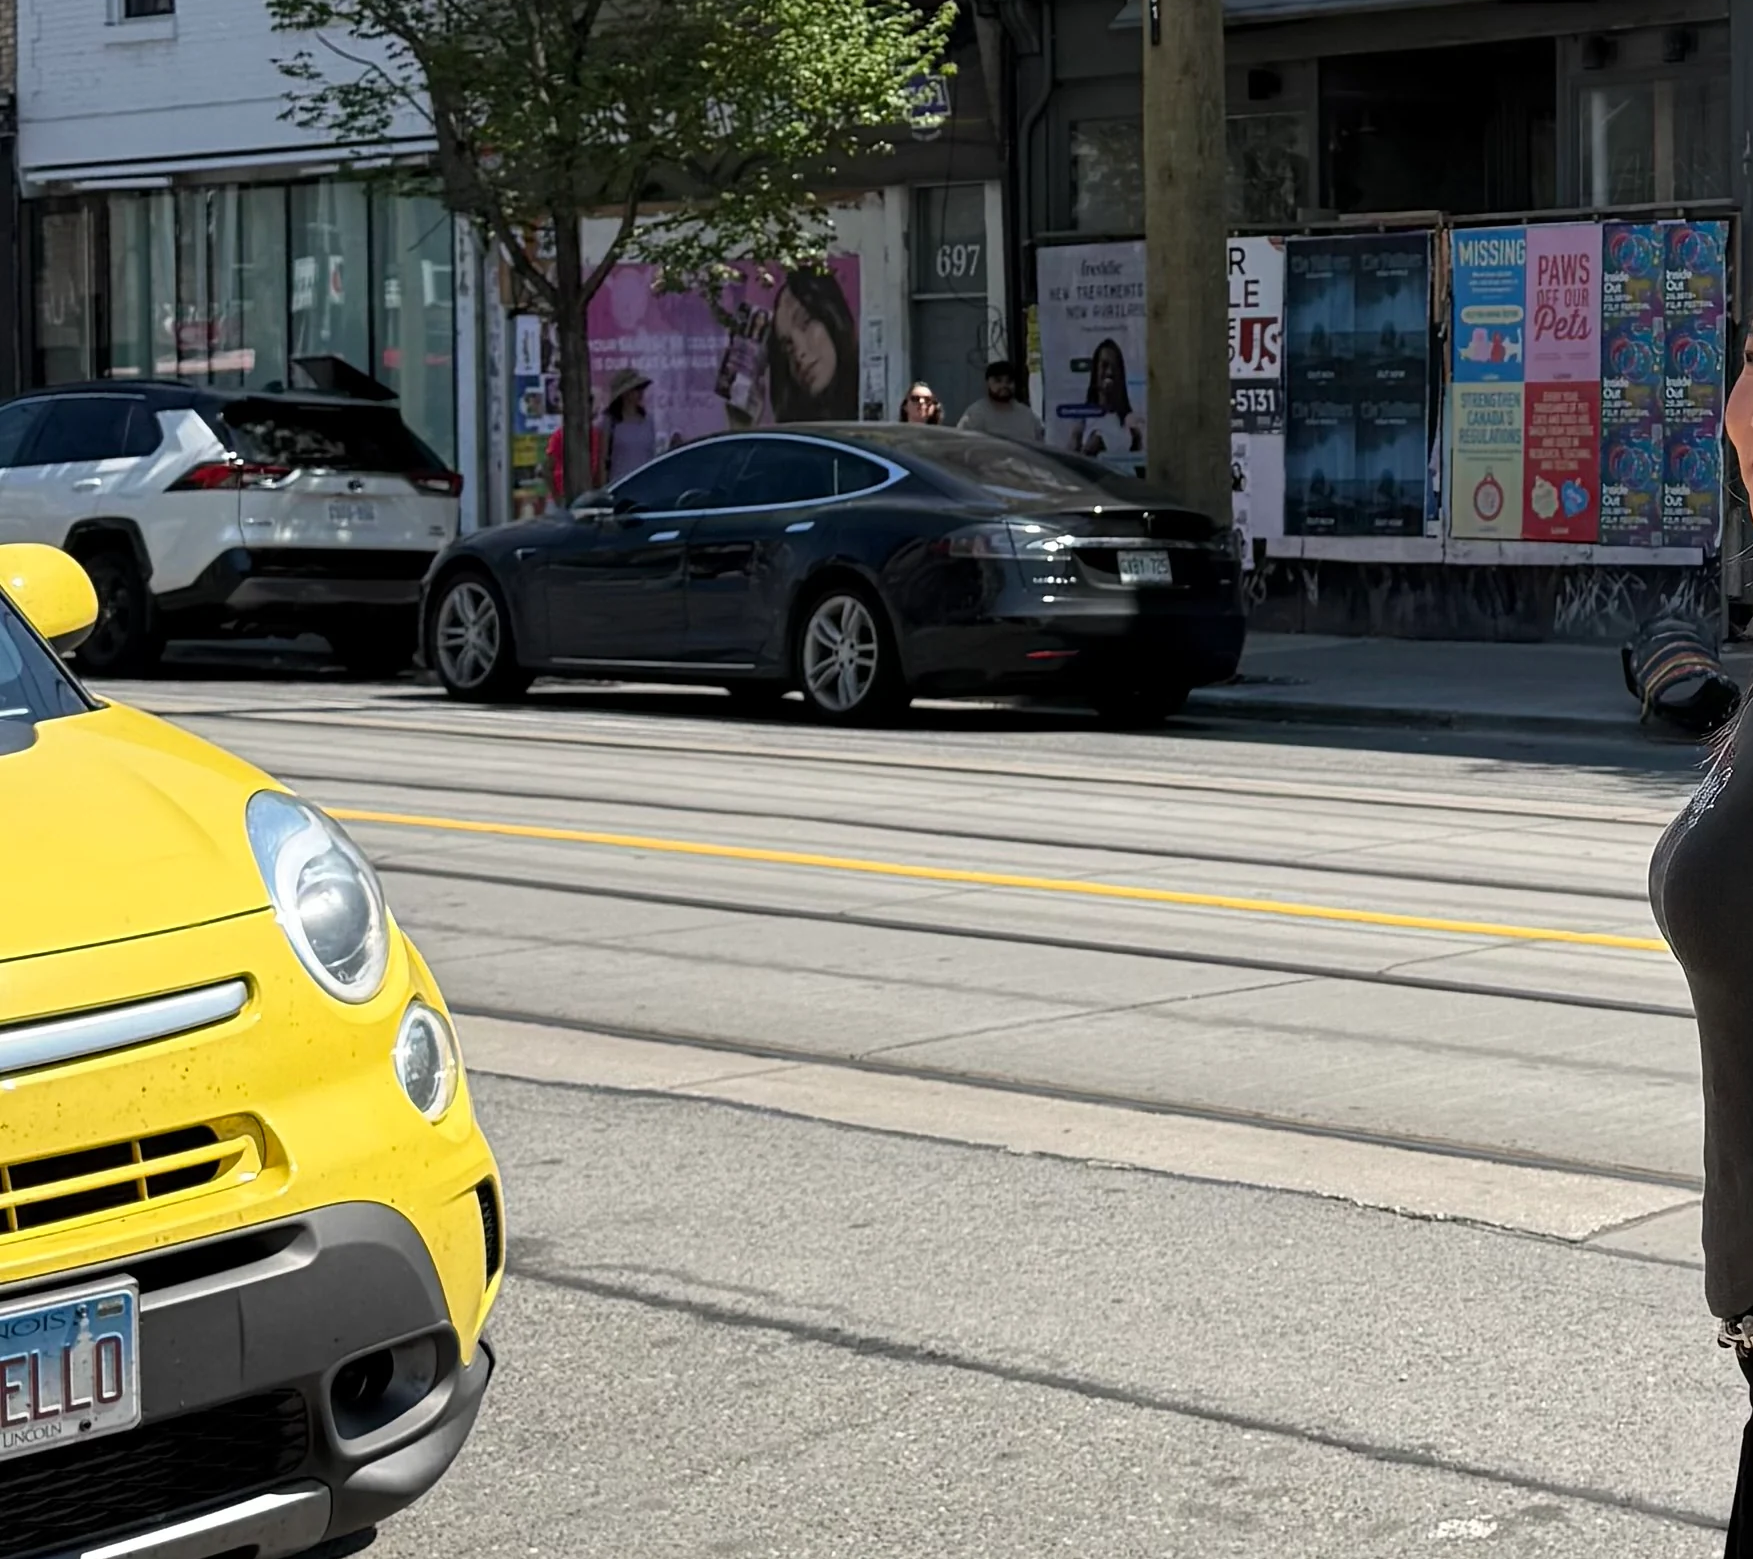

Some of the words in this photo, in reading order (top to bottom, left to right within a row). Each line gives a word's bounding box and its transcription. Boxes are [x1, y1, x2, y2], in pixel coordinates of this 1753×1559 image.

[1458, 238, 1525, 267] MISSING
[936, 244, 981, 278] 697
[1537, 253, 1590, 287] PAWS
[1603, 270, 1629, 282] Inside
[1666, 268, 1693, 280] Inside
[1603, 282, 1622, 294] Out
[1666, 280, 1684, 291] Out
[1536, 289, 1560, 308] OFF
[1564, 288, 1590, 308] OUR
[1534, 304, 1592, 342] Pets
[1603, 377, 1629, 388] Inside
[1665, 376, 1692, 388] Inside
[1603, 389, 1621, 400] Out
[1665, 388, 1684, 399] Out
[1602, 483, 1628, 495] Inside
[1664, 483, 1691, 495] Inside
[1602, 495, 1620, 507] Out
[1664, 495, 1683, 507] Out
[0, 1333, 125, 1429] ELLO
[2, 1421, 62, 1448] LINCOLN
